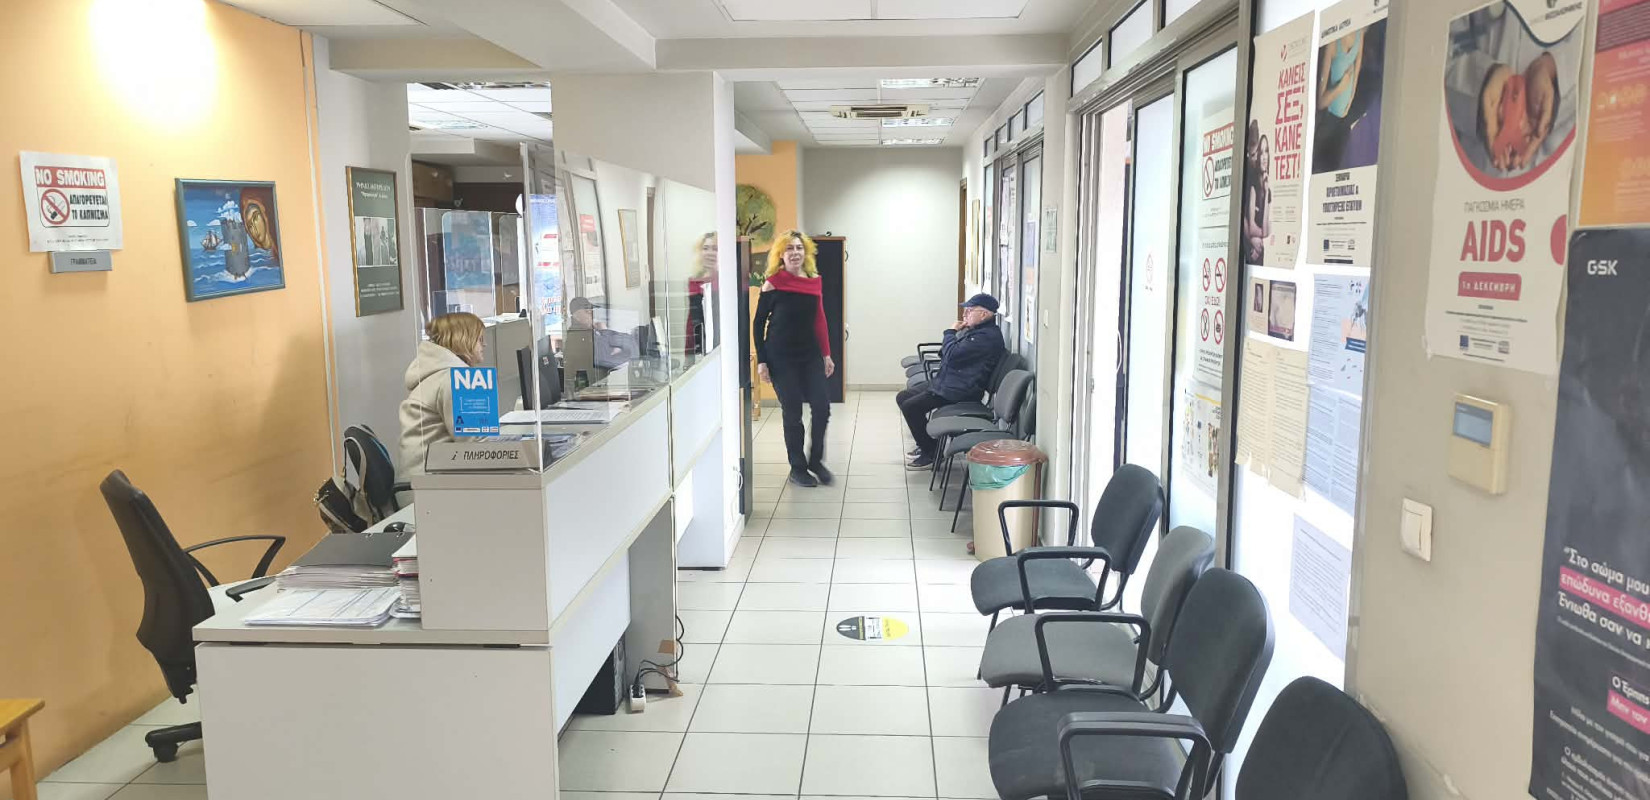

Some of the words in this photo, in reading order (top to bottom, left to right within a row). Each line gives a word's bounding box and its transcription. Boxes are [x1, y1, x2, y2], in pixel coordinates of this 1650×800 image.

[1278, 61, 1305, 90] ΚΑΝΕΙΣ
[1275, 122, 1302, 154] ΚΑΝΕ
[35, 168, 52, 185] NO
[56, 169, 104, 187] SMOKING
[1274, 152, 1301, 180] ΤΕΣΤ!
[69, 194, 108, 206] ΑΠΑΓΟΡΕΥΕΤΑΙ
[72, 209, 78, 220] ΤΟ
[79, 209, 108, 220] ΚΑΠΝΙΣΜΑ
[1460, 218, 1526, 263] AIDS
[1587, 260, 1618, 276] GSK
[453, 369, 493, 390] ΝΑΙ
[463, 450, 519, 461] ΠΛΗΡΟΦΟΡΙΕΣ
[1560, 573, 1610, 604] επώδυνα
[1591, 561, 1624, 584] σώμα
[1626, 577, 1650, 595] μου
[1558, 590, 1597, 623] Ένιωθα
[1599, 616, 1624, 635] σαν
[1626, 628, 1642, 645] να
[1612, 676, 1621, 688] Ο
